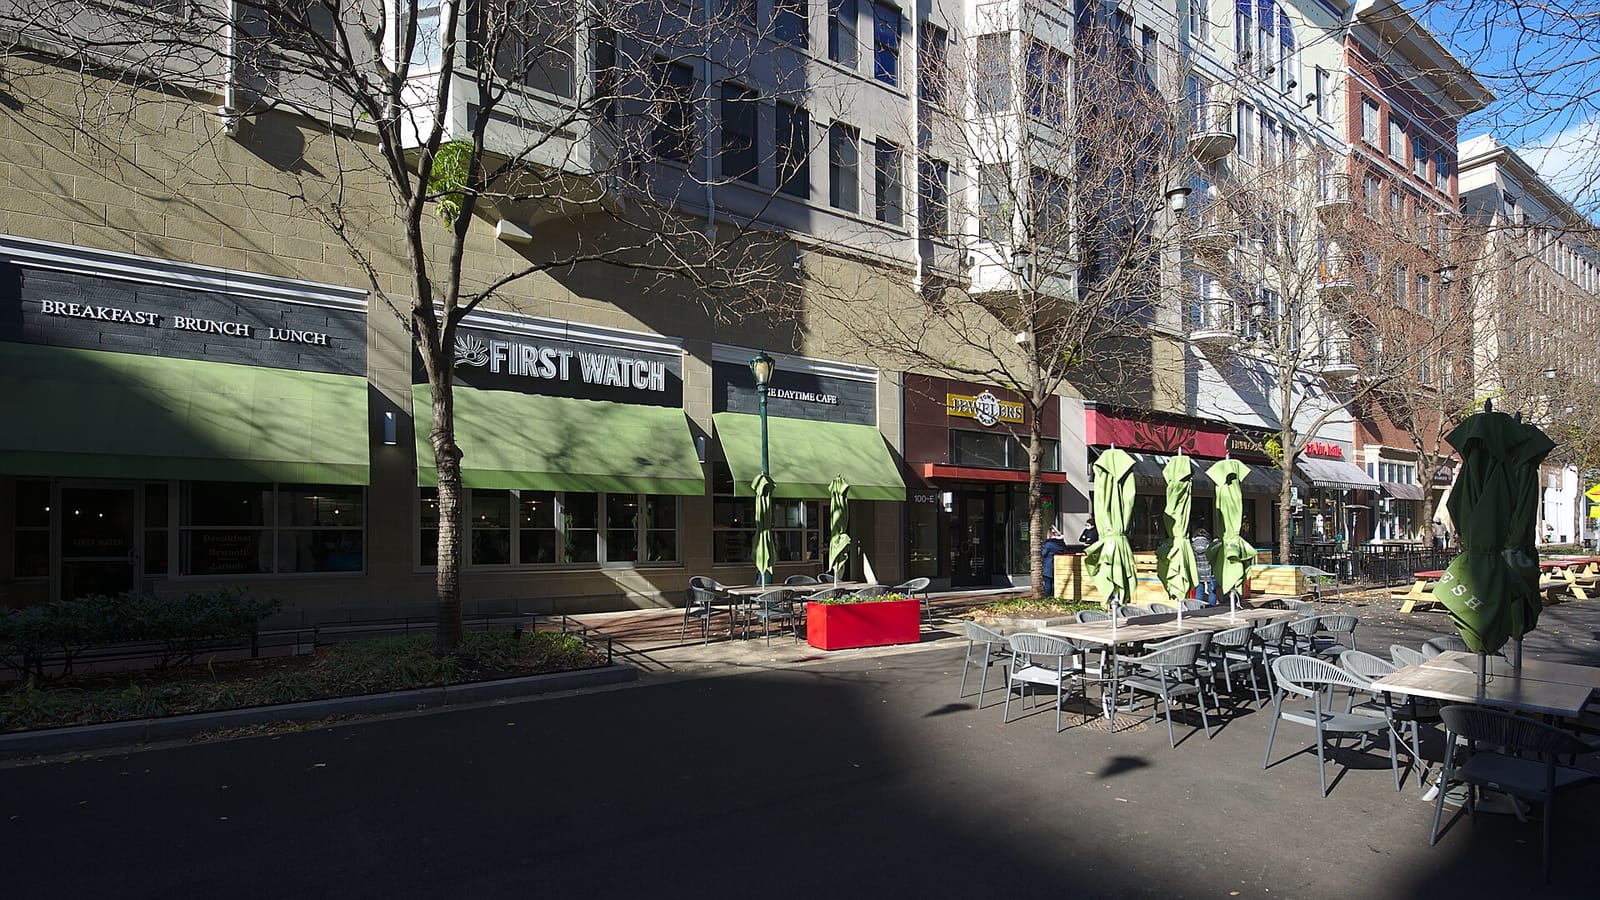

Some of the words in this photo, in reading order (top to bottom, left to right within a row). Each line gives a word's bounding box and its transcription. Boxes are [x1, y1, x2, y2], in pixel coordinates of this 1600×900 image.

[41, 299, 159, 327] BREAKFAST
[173, 315, 250, 337] BRUNCH
[268, 328, 328, 346] LUNCH
[489, 339, 574, 381] FIRST
[578, 351, 666, 392] WATCH
[777, 389, 815, 402] DAYTIME
[815, 393, 837, 404] CAFE
[979, 394, 995, 403] TOWN
[951, 398, 1023, 419] JEWELERS
[913, 494, 935, 504] 100-E
